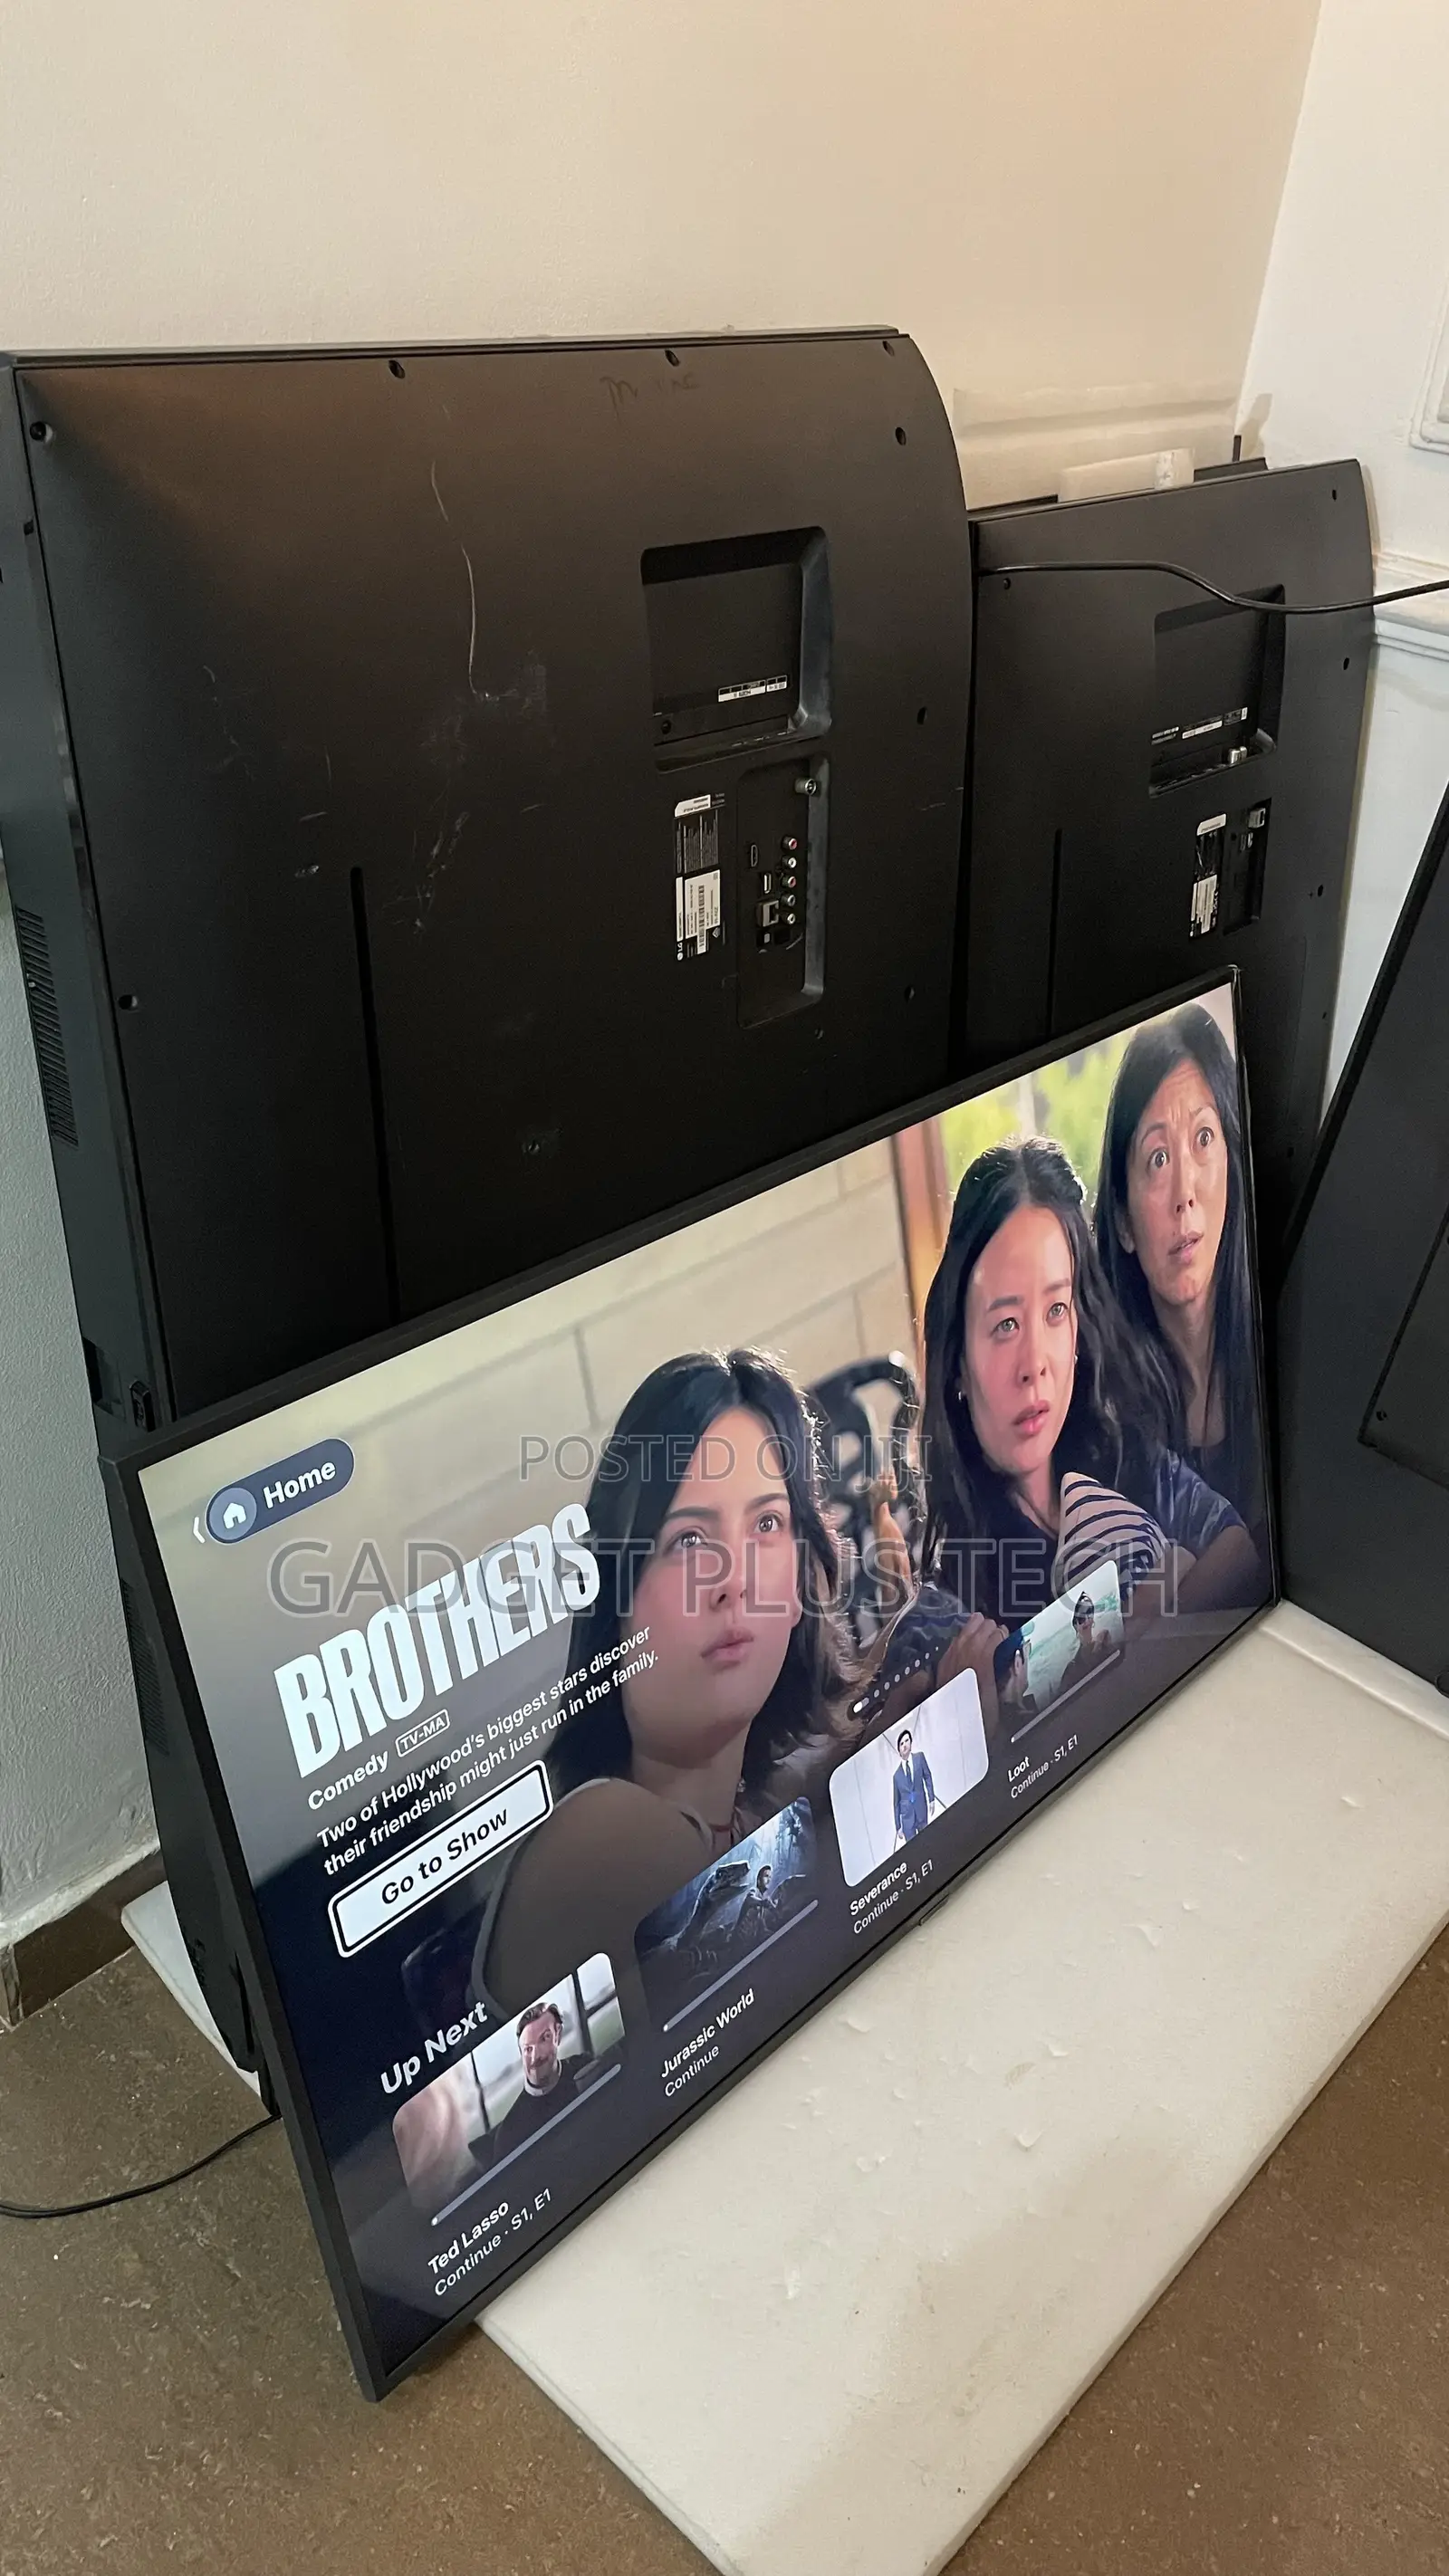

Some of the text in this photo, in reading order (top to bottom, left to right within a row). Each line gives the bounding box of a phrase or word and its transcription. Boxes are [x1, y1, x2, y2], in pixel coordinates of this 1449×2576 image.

[264, 1459, 336, 1509] Home
[273, 1503, 600, 1778] BROTHERS
[308, 1716, 446, 1810] Comedy TV-MA
[317, 1626, 651, 1848] Two of Hollywood's biggest stars discover
[324, 1651, 659, 1876] their friendship might just run in the family.
[1007, 1756, 1031, 1783] Loot
[1011, 1761, 1049, 1799] Continue
[1068, 1734, 1079, 1750] E1
[380, 1808, 509, 1905] Go to Show
[849, 1861, 908, 1916] Severance
[853, 1859, 934, 1935] Continue S1, E1
[380, 2001, 489, 2095] Up Next
[661, 1988, 755, 2078] Jurassic World
[665, 2045, 720, 2097] Continue
[427, 2201, 510, 2275] Ted Lasso
[434, 2188, 552, 2296] Continue S1, E1
